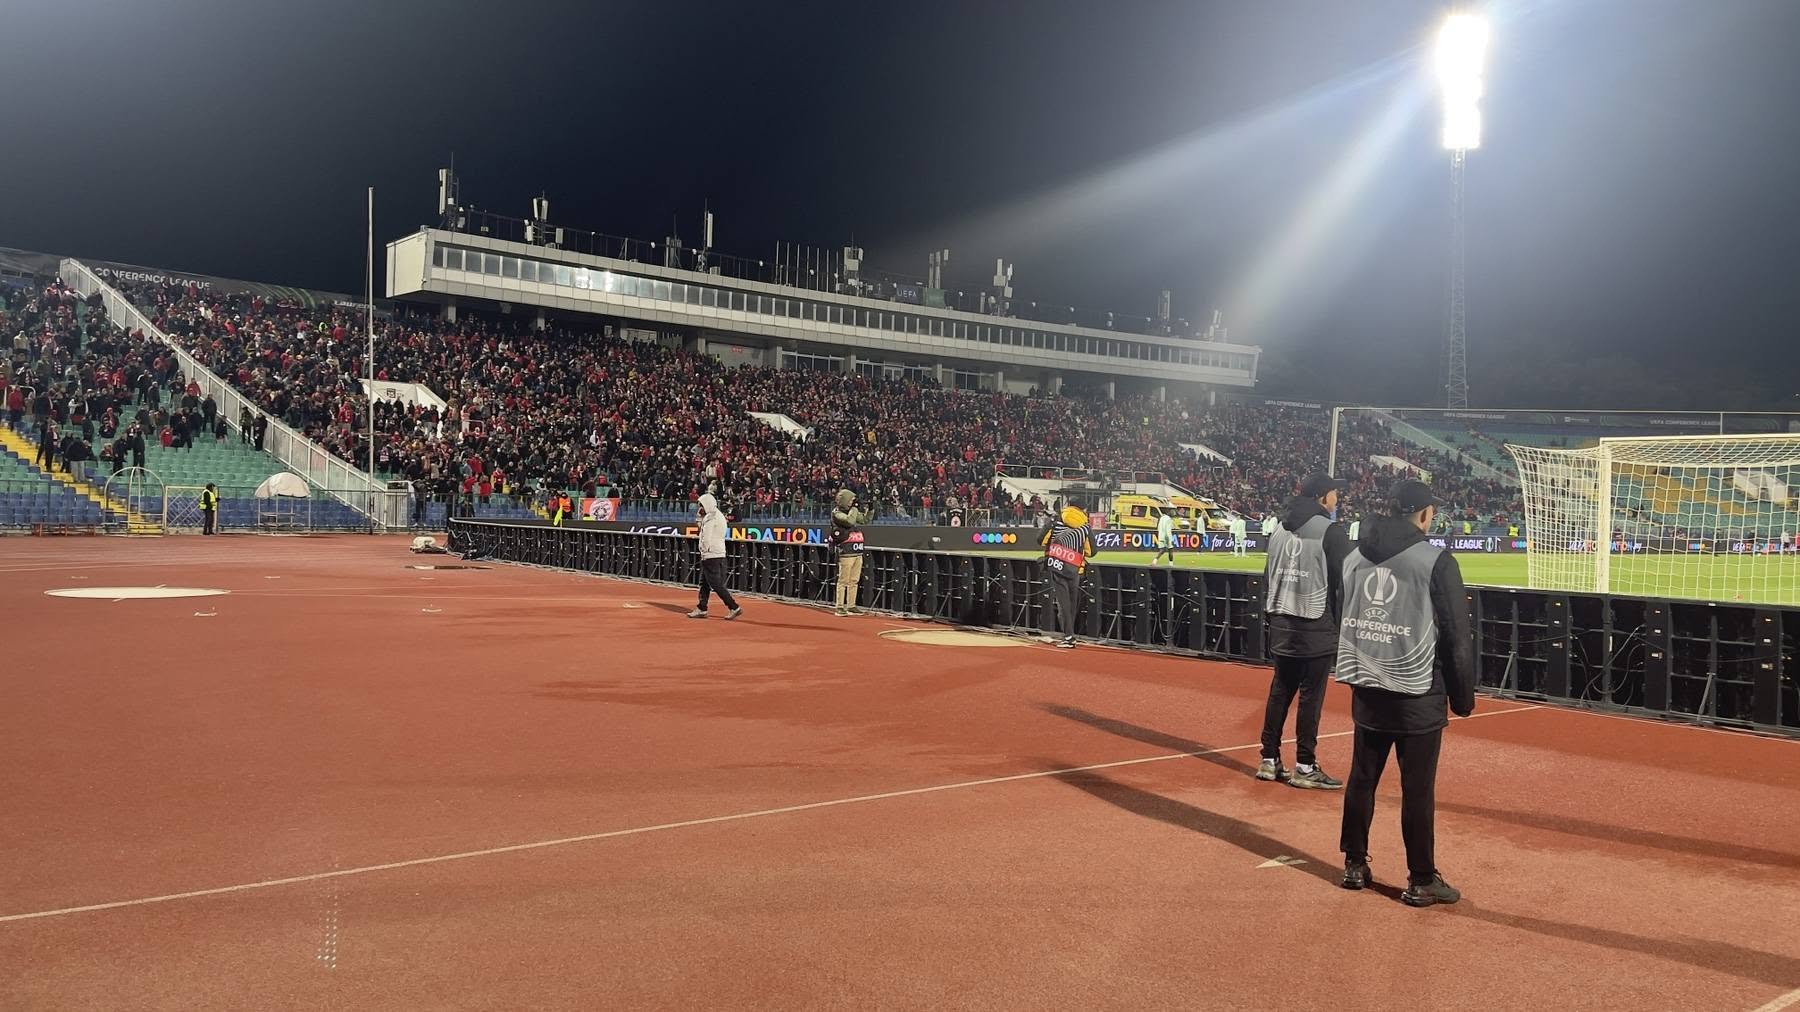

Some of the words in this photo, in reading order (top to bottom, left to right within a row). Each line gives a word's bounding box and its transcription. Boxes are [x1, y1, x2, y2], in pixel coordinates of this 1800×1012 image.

[897, 287, 917, 298] UEFA
[685, 527, 821, 545] FNDATION
[1094, 532, 1120, 548] EFA
[1123, 533, 1209, 549] FOUNATION
[1455, 539, 1484, 550] LEAGUE
[1342, 617, 1412, 637] CONFERENCE
[1355, 629, 1393, 644] LEAGUE
